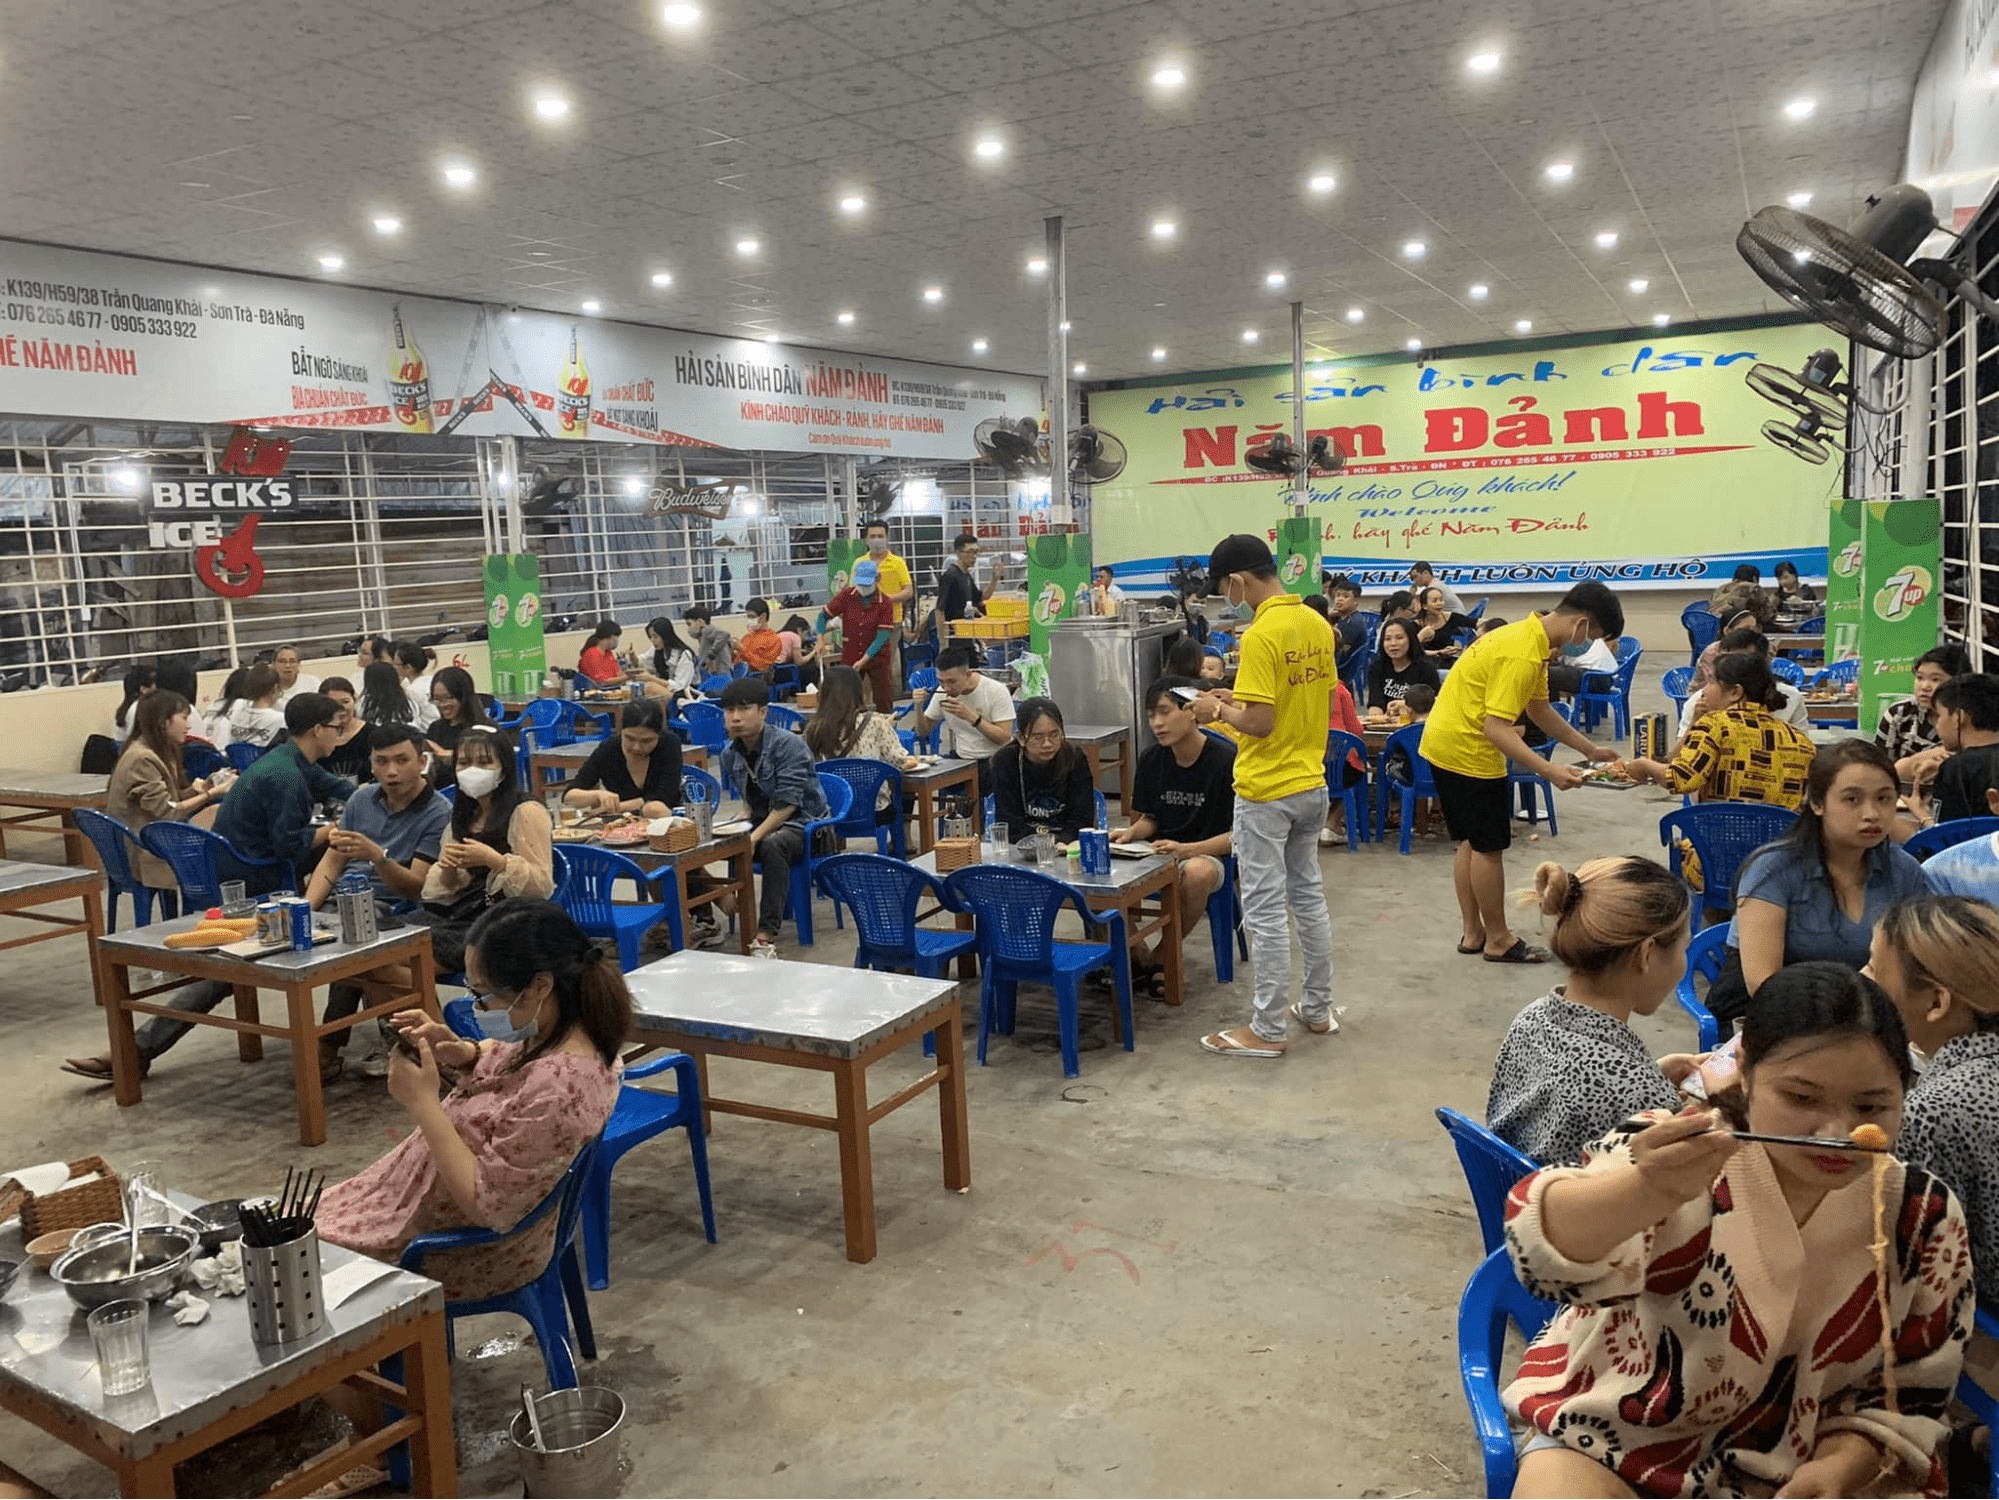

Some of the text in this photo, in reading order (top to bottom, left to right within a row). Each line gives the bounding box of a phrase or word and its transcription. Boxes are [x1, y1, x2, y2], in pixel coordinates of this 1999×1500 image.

[7, 279, 99, 305] K139/H59/38
[132, 293, 173, 315] Quang
[7, 303, 35, 322] 076
[37, 305, 64, 325] 265
[67, 310, 85, 328] 46
[87, 312, 101, 329] 77
[111, 314, 146, 333] 0905
[148, 317, 172, 336] 333
[174, 321, 198, 338] 922
[675, 350, 703, 386] HẢI
[704, 353, 735, 389] SẢN
[737, 360, 771, 392] BÌNH
[1424, 392, 1705, 453] Đảnh
[1490, 458, 1512, 467] 076
[1516, 456, 1538, 465] 265
[1562, 453, 1577, 462] 77
[1590, 451, 1620, 460] 0905
[1625, 450, 1648, 459] 333
[1652, 448, 1676, 457] 922
[152, 477, 292, 508] BECK'S
[648, 487, 732, 511] Budweiser
[149, 519, 222, 548] ICE
[1471, 563, 1557, 580] LUÔN
[1652, 557, 1708, 580] HỘ
[1640, 724, 1648, 756] LARU
